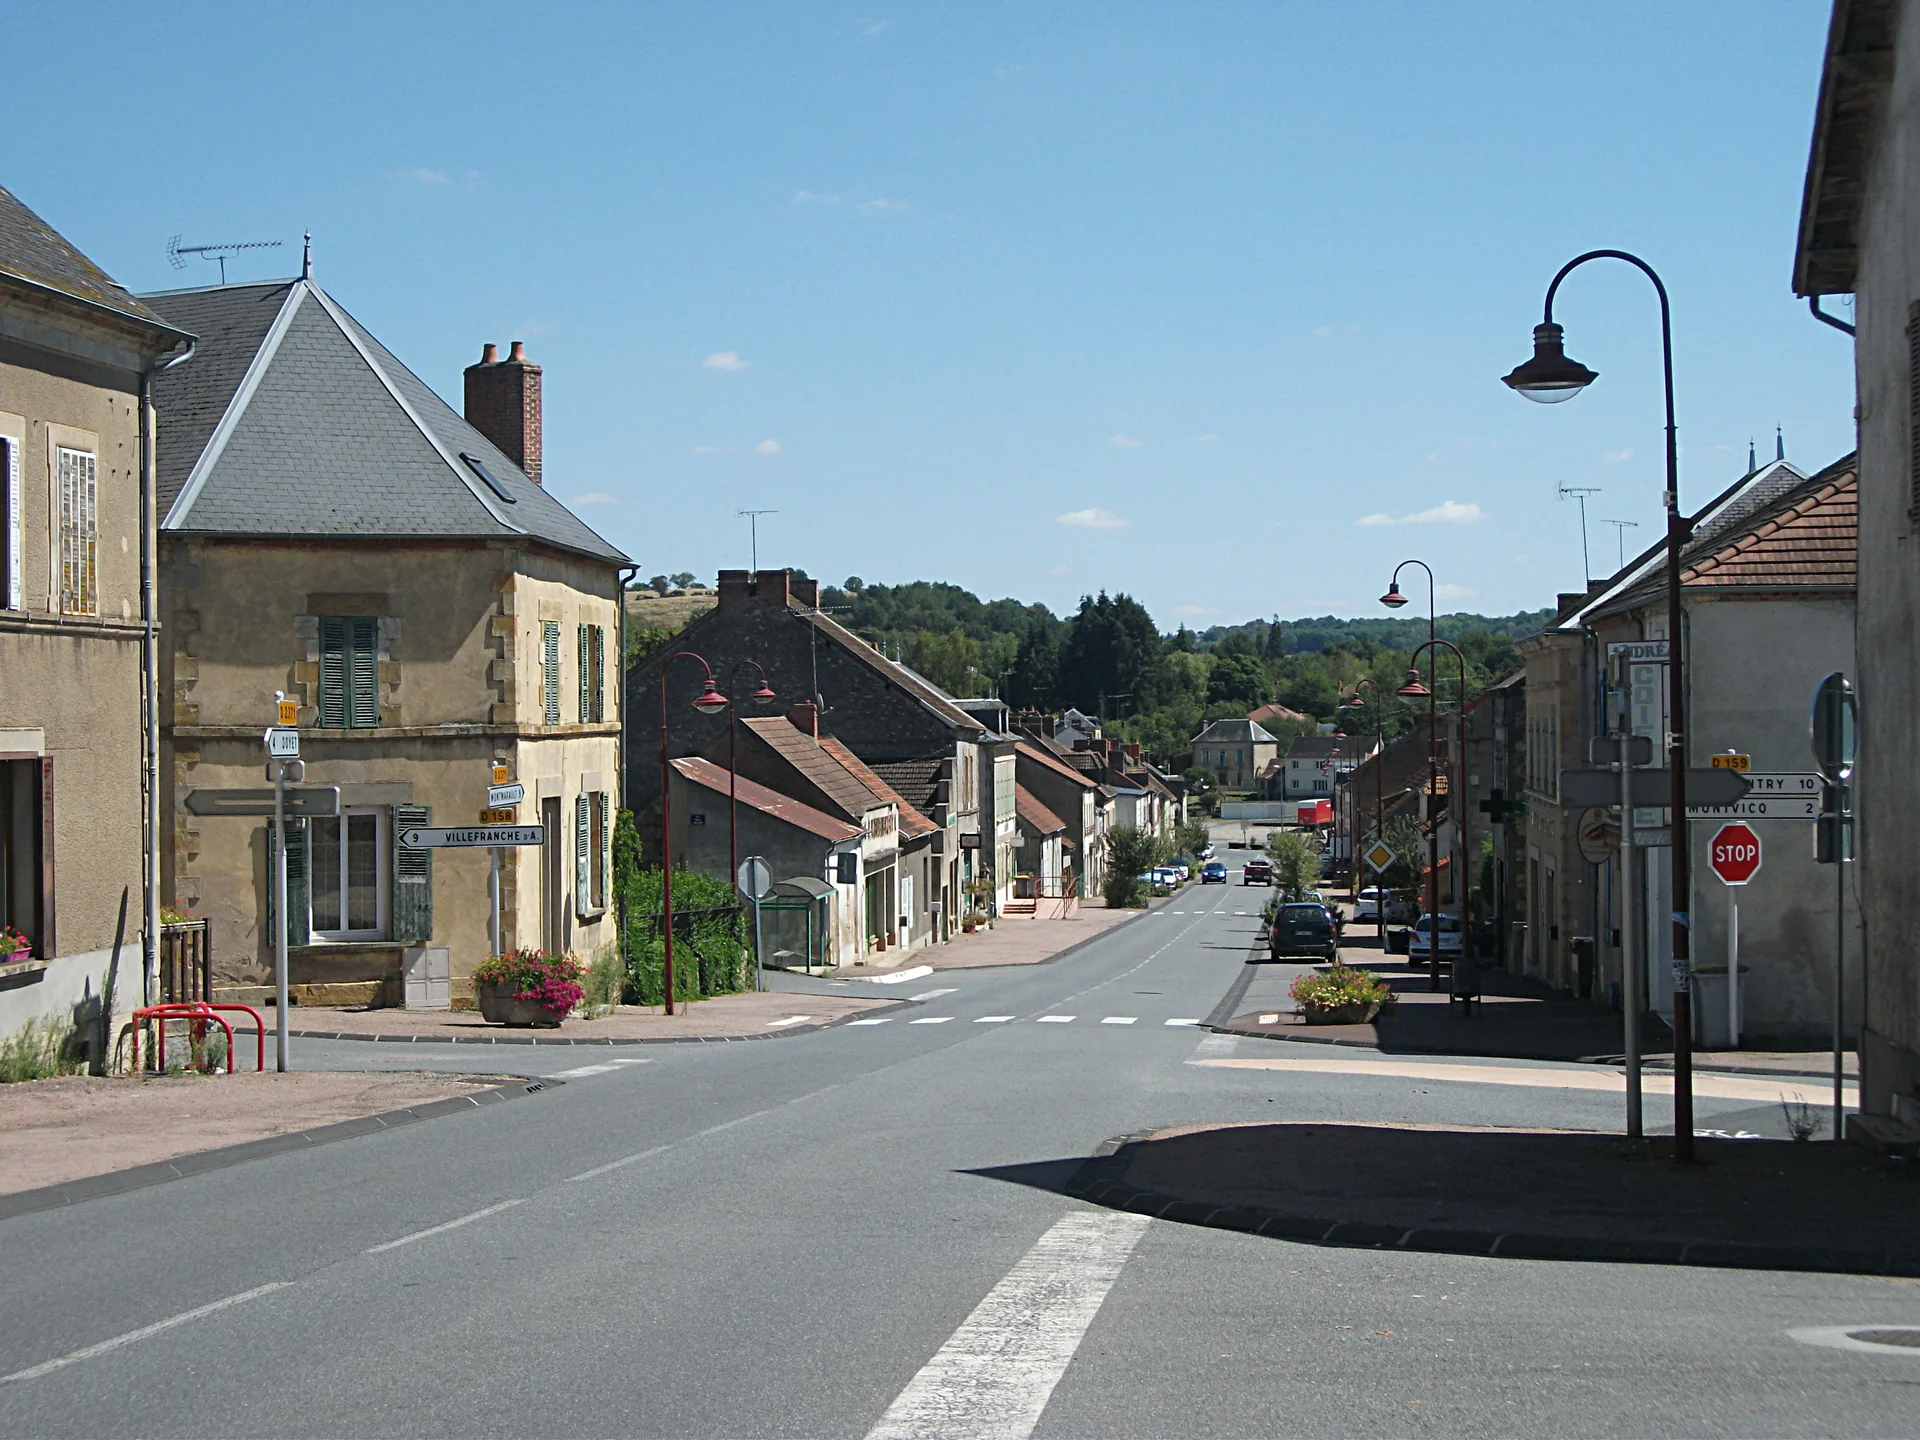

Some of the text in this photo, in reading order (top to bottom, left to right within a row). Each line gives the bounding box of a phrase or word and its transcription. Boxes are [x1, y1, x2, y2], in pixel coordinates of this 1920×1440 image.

[282, 736, 297, 750] DOYET
[1712, 757, 1748, 768] D 159
[1799, 779, 1814, 790] 10
[1805, 803, 1813, 814] 2
[481, 811, 512, 821] D 158
[412, 833, 419, 843] 9
[445, 831, 520, 842] VILLEFRANCHE
[1716, 845, 1756, 863] STOP
